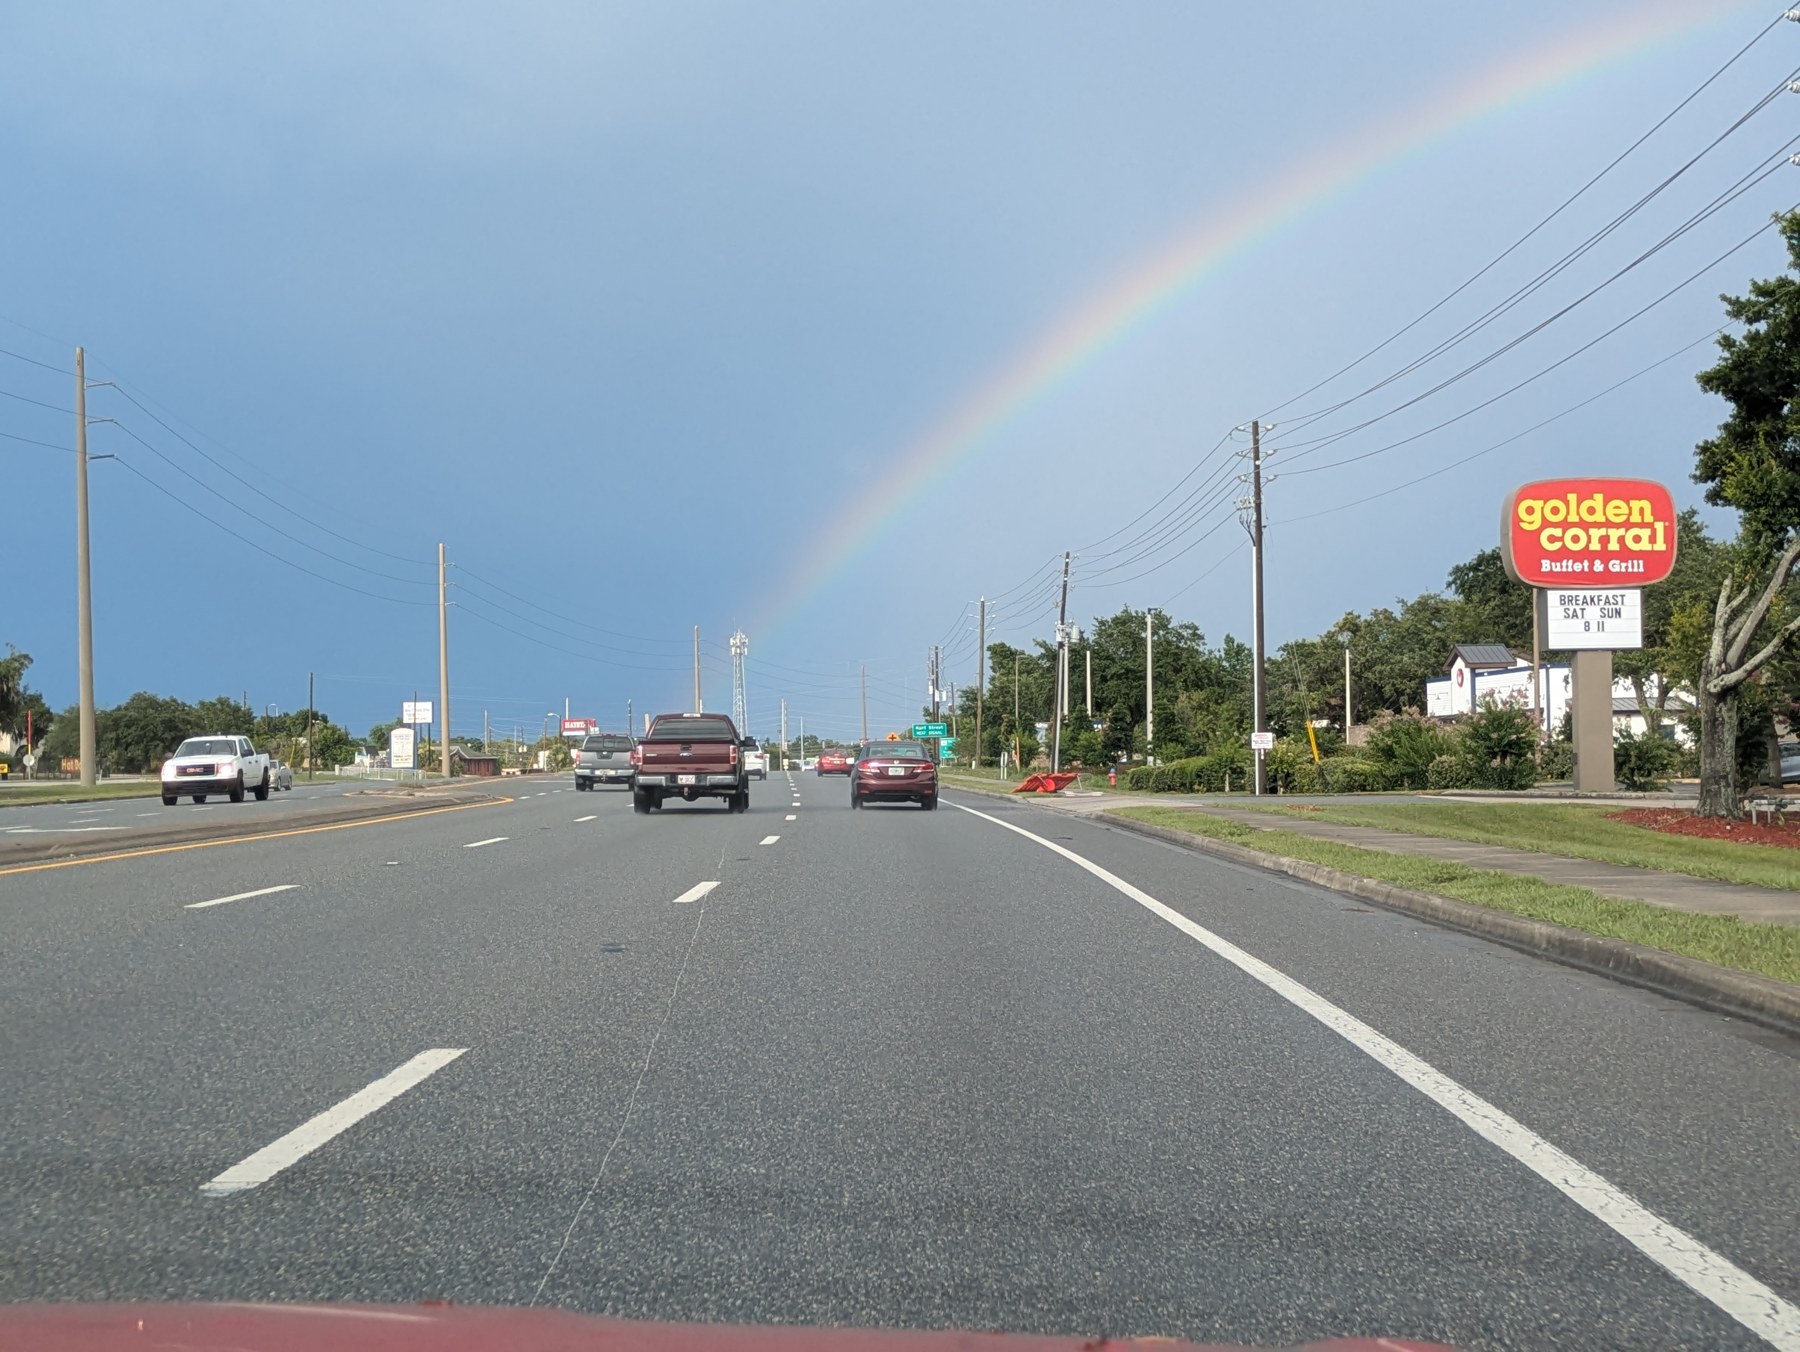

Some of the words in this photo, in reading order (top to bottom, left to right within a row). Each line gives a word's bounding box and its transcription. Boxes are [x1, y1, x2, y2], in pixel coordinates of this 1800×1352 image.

[1517, 493, 1654, 530] golden
[1539, 521, 1667, 551] corral
[1540, 559, 1590, 572] Buffet
[1592, 559, 1604, 572] &
[1608, 559, 1645, 573] Grill
[1559, 594, 1626, 606] BREAKFAST
[1563, 607, 1587, 619] SAT
[1599, 607, 1622, 619] SUN
[1583, 620, 1591, 632] 8
[61, 758, 74, 771] Hot
